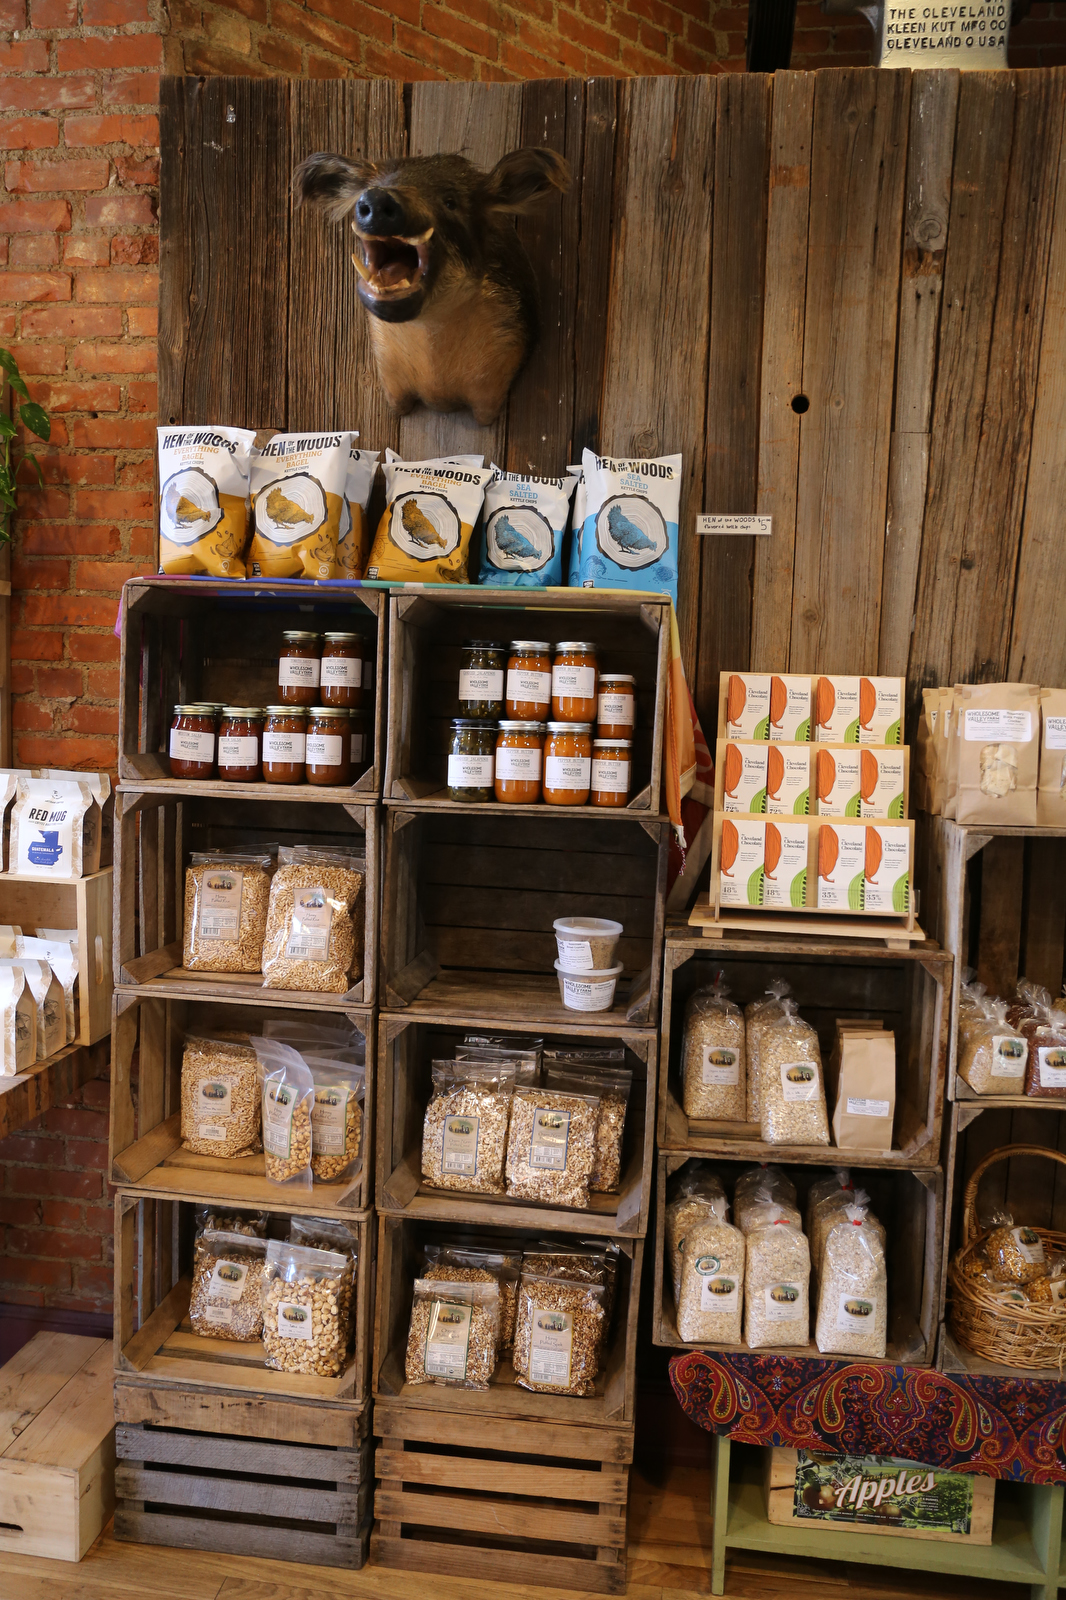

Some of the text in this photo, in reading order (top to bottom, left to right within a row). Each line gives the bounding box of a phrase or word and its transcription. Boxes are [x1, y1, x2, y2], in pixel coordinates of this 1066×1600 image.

[890, 5, 1005, 19] THE CLEVELAND
[887, 20, 1006, 34] KLEEN KUT MFG CO
[887, 35, 1005, 49] CLEVELAND O USA
[162, 434, 184, 450] HEN
[183, 439, 192, 447] THE
[193, 432, 239, 455] WOODS
[173, 445, 220, 455] EVERYTHING
[260, 442, 286, 457] HEN
[285, 446, 295, 455] THE
[296, 435, 342, 453] WOODS
[182, 453, 204, 462] BAGEL
[275, 450, 323, 464] EVERYTHING
[285, 458, 309, 469] BAGEL
[595, 456, 617, 473] HEN
[628, 461, 674, 480] WOODS
[410, 473, 462, 487] EVERYTHING
[421, 479, 448, 490] BAGEL
[433, 469, 482, 486] WOODS
[508, 472, 520, 482] THE
[520, 474, 566, 490] WOODS
[620, 478, 649, 490] SALTED
[627, 473, 642, 482] SEA
[419, 484, 435, 492] KETTLE
[516, 483, 531, 491] SEA
[509, 490, 539, 500] SALTED
[28, 808, 68, 823] RED MUG
[565, 980, 592, 989] WHOLESOME
[834, 1469, 937, 1509] Apples
